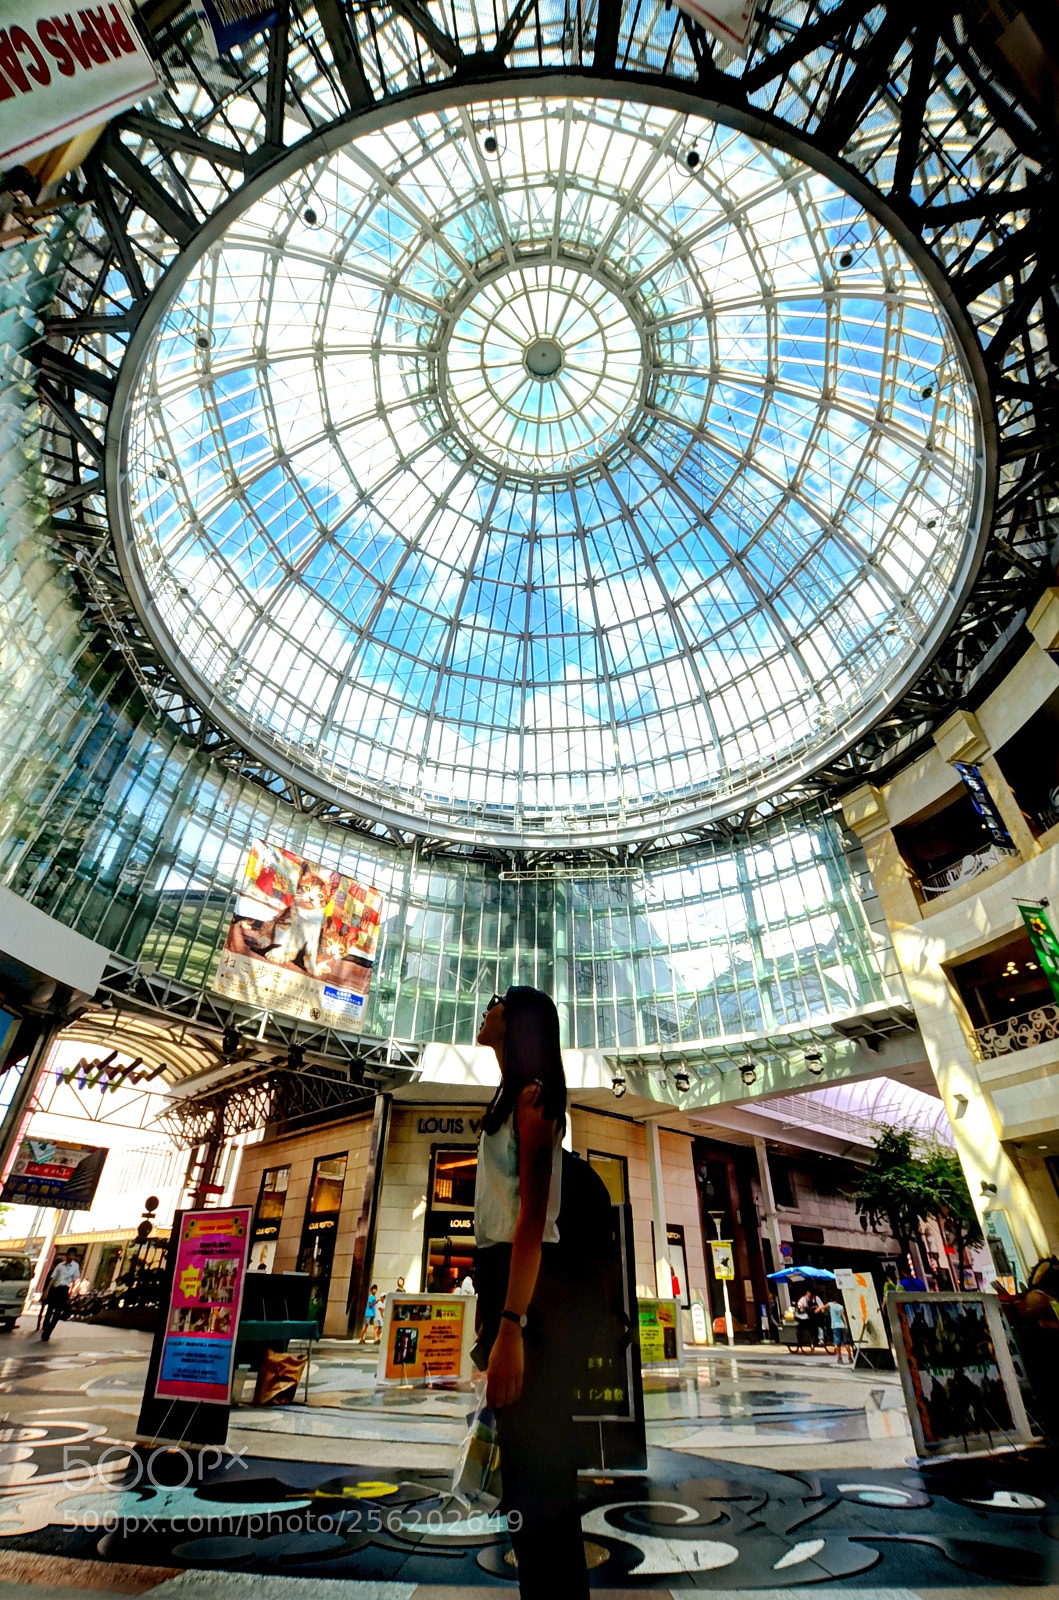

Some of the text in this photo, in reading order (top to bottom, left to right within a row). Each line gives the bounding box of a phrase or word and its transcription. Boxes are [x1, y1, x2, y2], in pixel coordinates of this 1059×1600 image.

[37, 2, 138, 78] PAPAS
[417, 1117, 464, 1134] LOUIS
[449, 1219, 472, 1228] LOUIS
